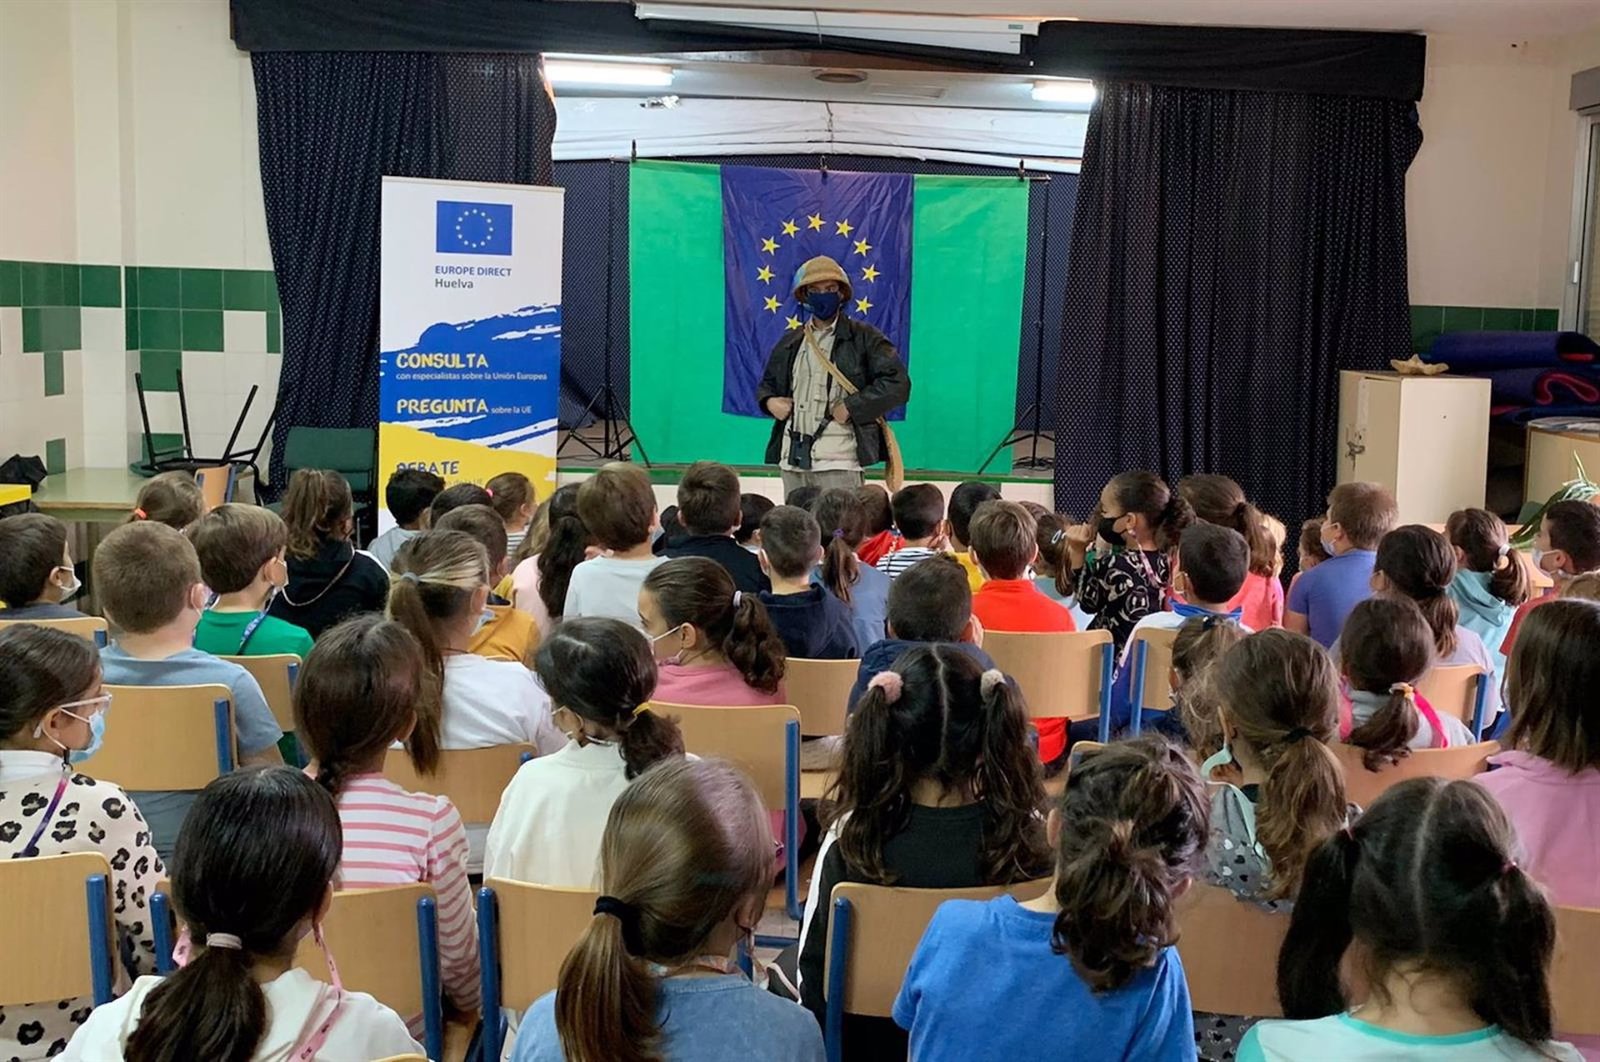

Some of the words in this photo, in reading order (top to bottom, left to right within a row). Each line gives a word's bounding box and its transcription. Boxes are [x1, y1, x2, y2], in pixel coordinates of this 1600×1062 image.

[435, 265, 475, 276] EUROPE
[477, 267, 512, 277] DIRECT
[435, 278, 474, 289] Huelva
[396, 352, 489, 369] CONSULTA
[396, 372, 410, 380] con
[412, 372, 460, 382] especialistas
[461, 372, 483, 380] sobre
[485, 372, 492, 380] la
[493, 371, 515, 380] Unión
[517, 372, 548, 382] Europea
[397, 398, 489, 414] PREGUNTA
[491, 406, 512, 415] sobre
[513, 406, 520, 415] la
[521, 406, 532, 415] UE
